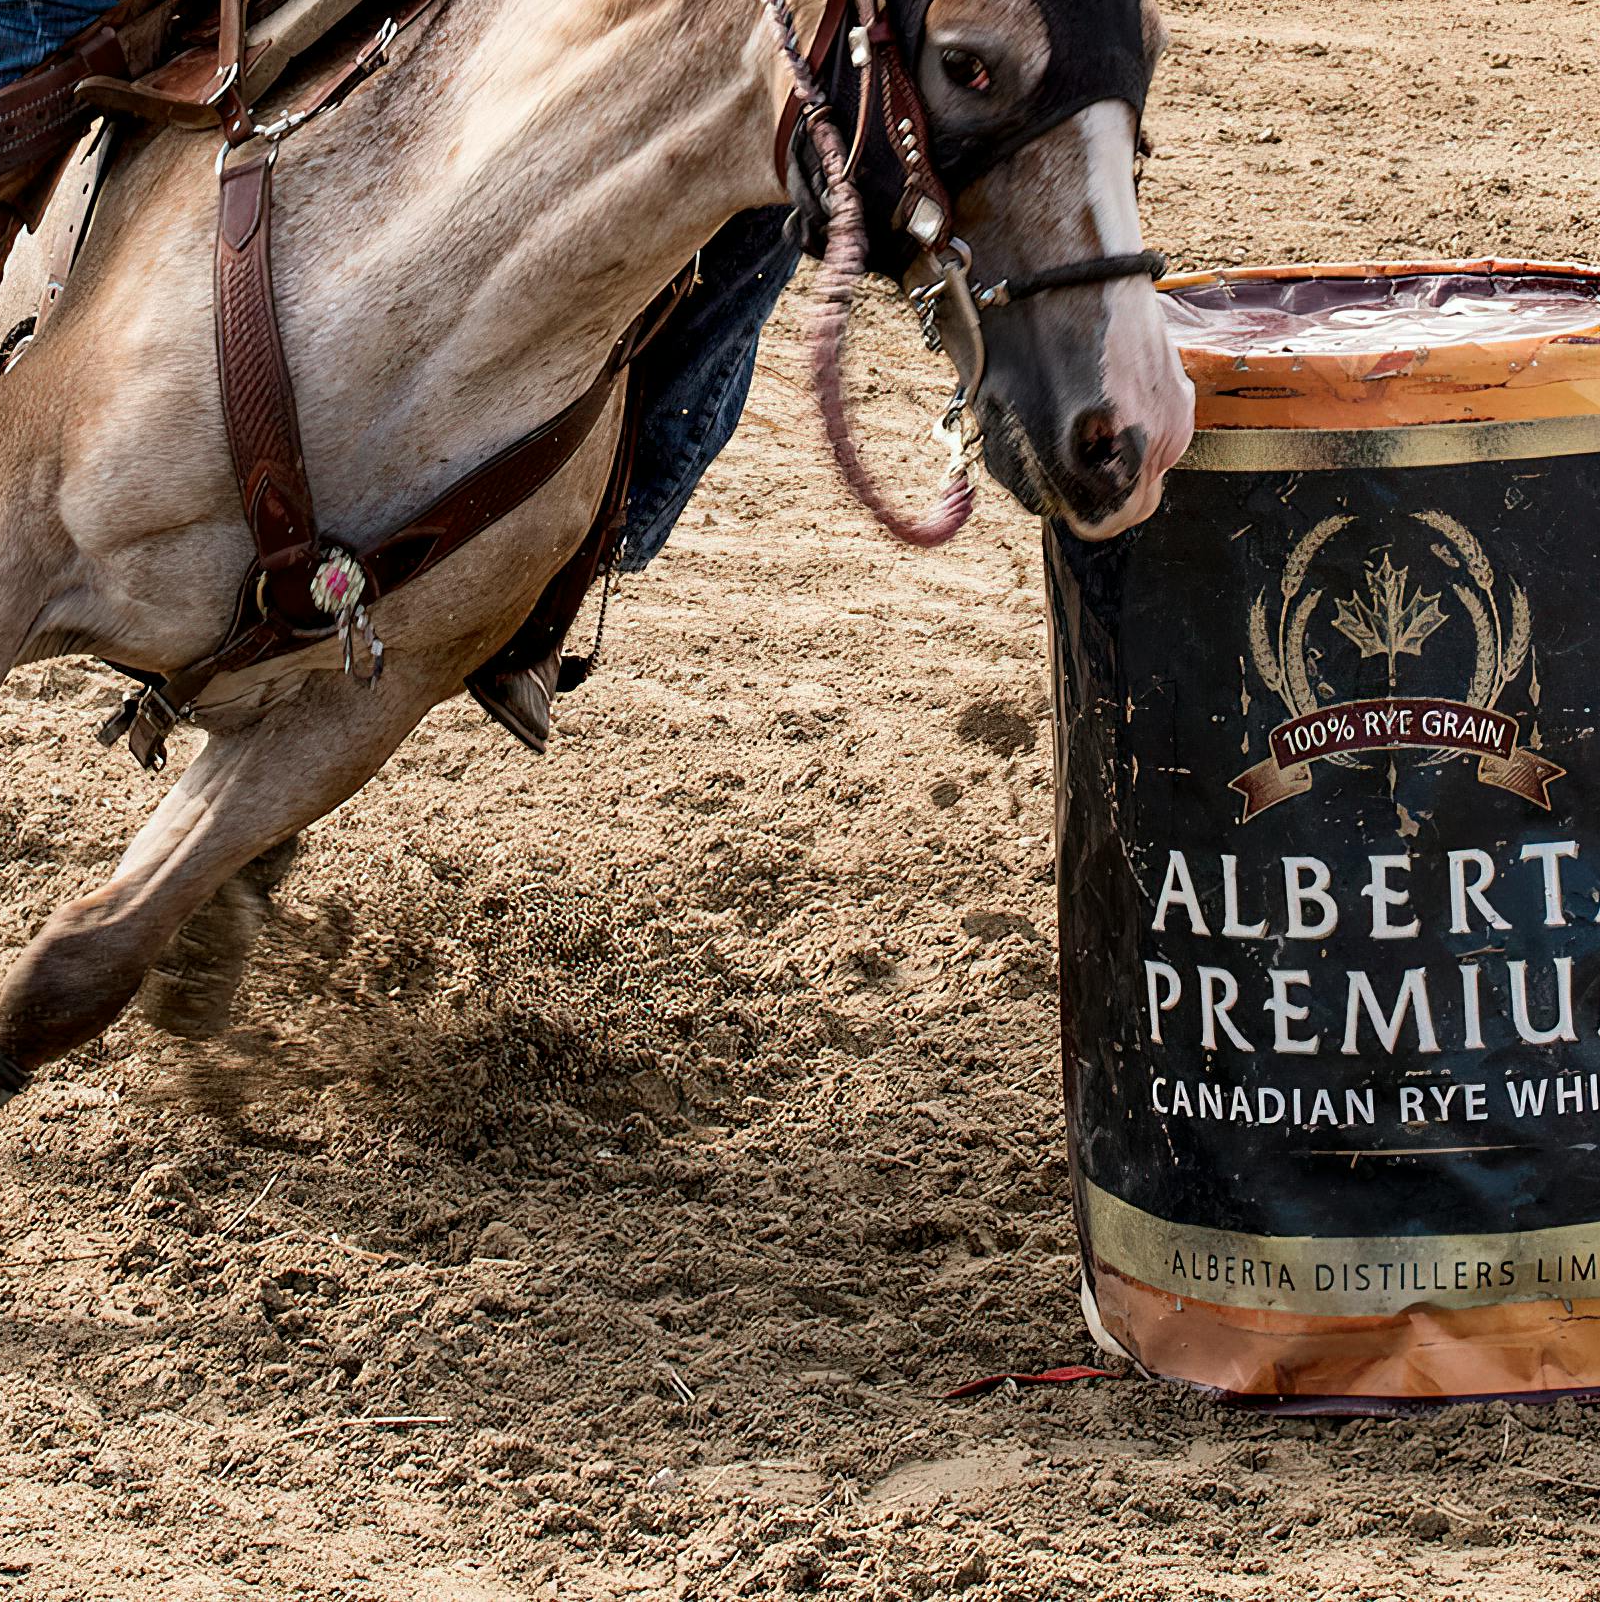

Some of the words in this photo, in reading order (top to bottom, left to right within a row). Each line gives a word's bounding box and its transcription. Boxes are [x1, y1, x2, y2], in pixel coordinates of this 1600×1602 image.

[1282, 714, 1355, 756] 100%
[1364, 710, 1412, 736] RYE
[1422, 710, 1506, 748] GRAIN
[1151, 1077, 1375, 1125] CANADIAN
[1399, 1084, 1489, 1123] RYE
[1171, 1249, 1296, 1291] ALBERTA
[1315, 1260, 1516, 1292] DISTILLERS
